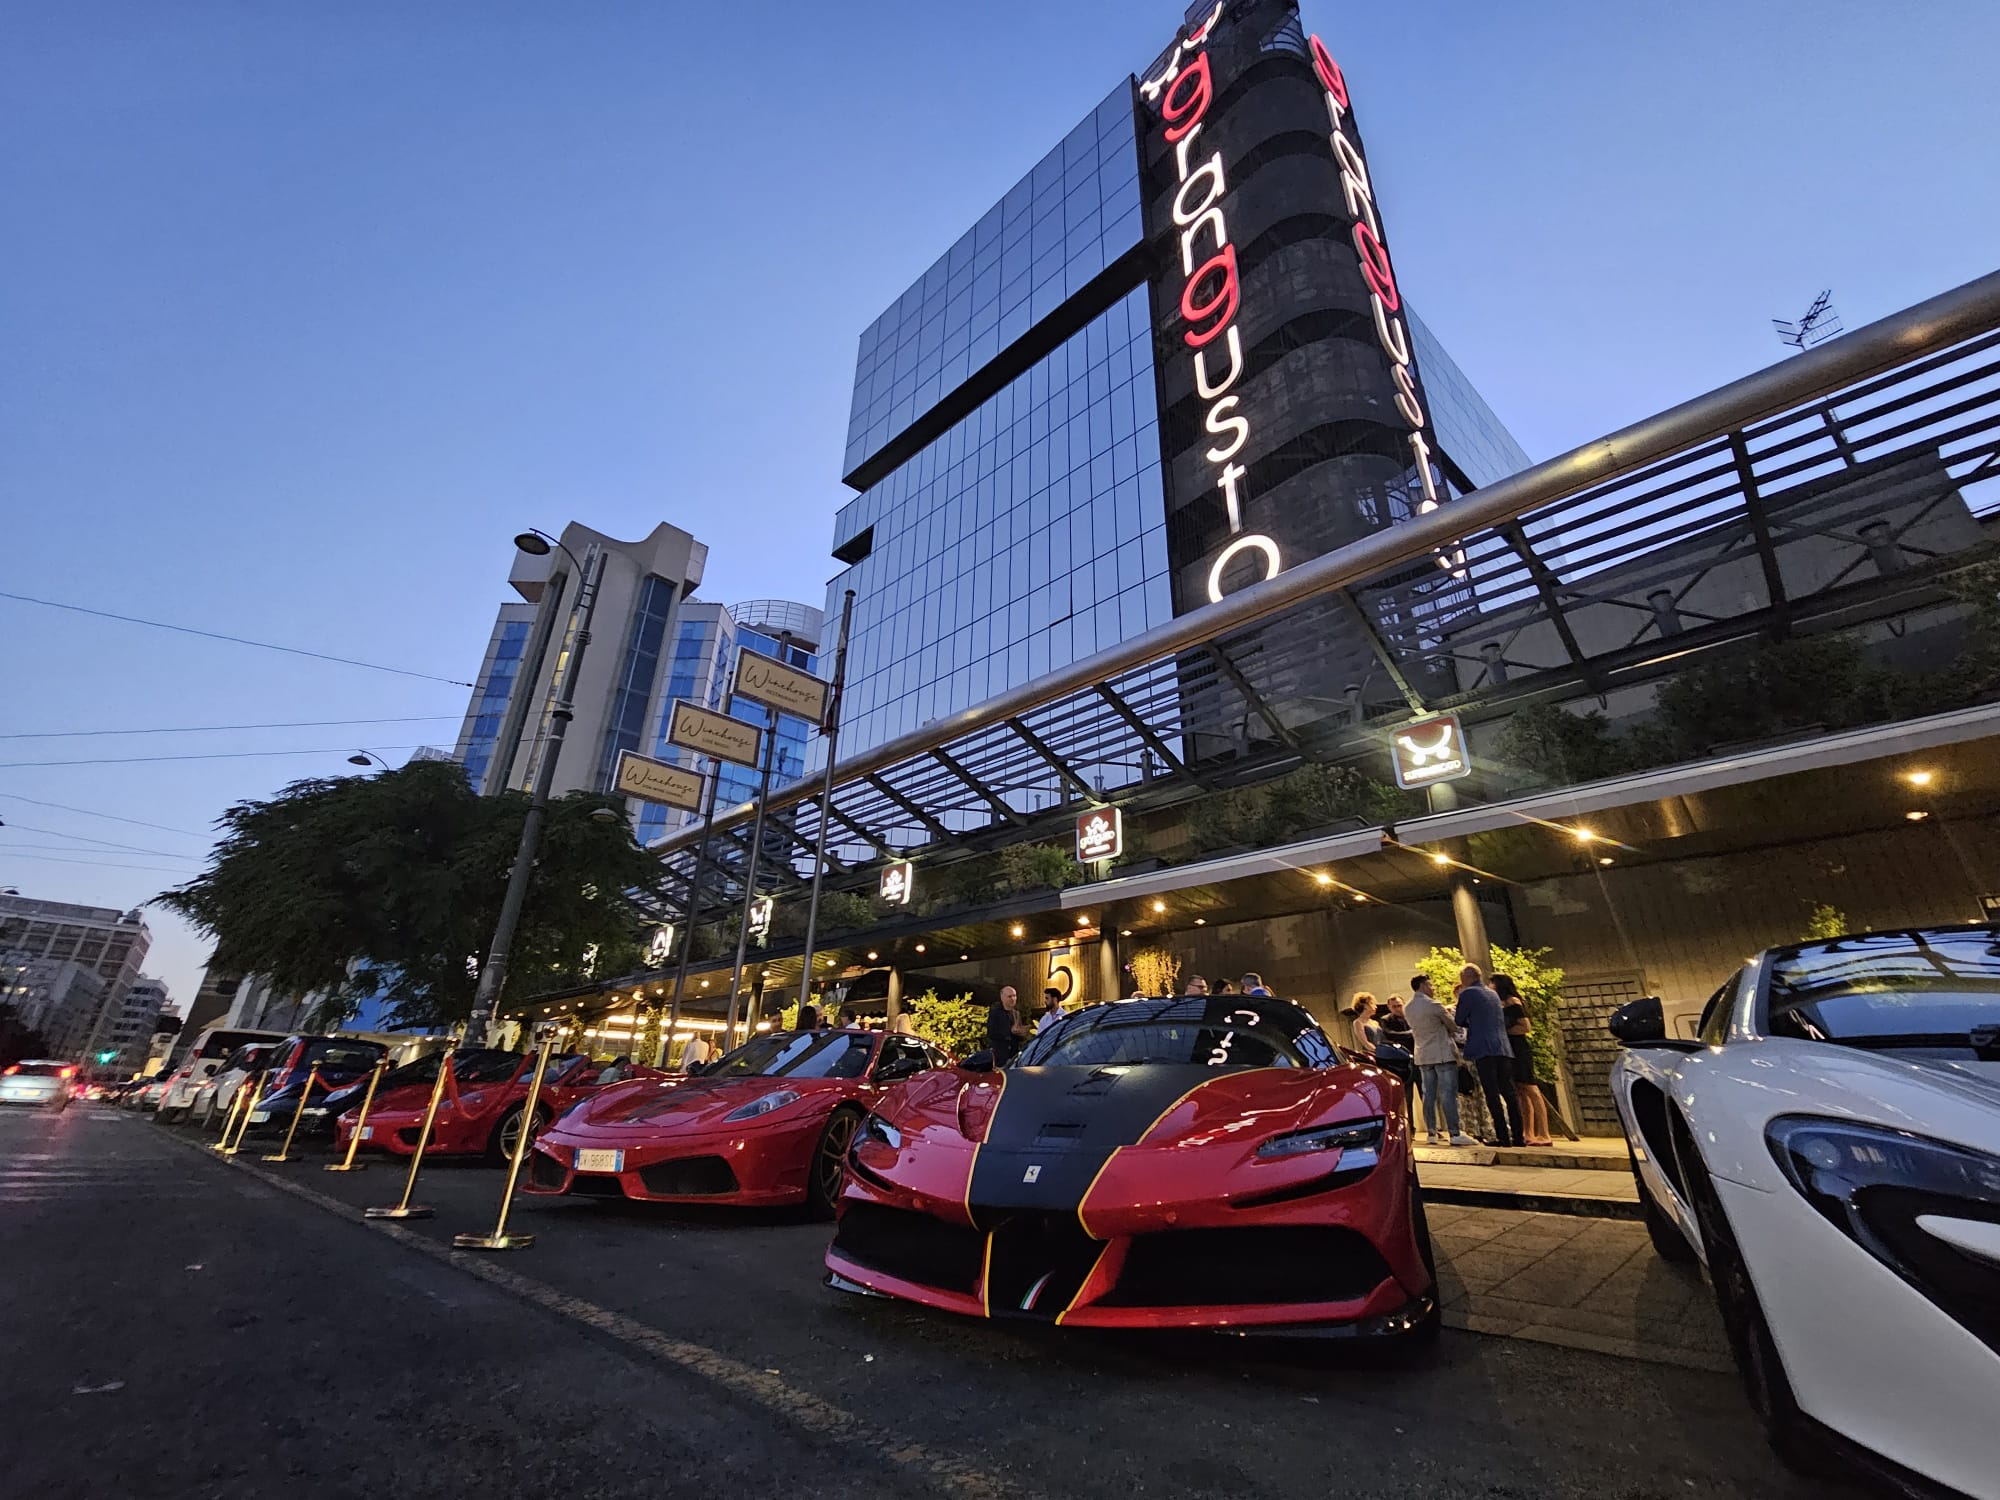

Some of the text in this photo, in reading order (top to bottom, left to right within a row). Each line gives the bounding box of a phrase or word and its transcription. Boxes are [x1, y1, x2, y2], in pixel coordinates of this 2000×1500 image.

[1162, 51, 1281, 604] grangusto
[745, 665, 818, 703] Winehouse
[680, 715, 752, 747] Winehouse
[626, 765, 696, 793] Winehouse
[1048, 947, 1073, 1001] 5
